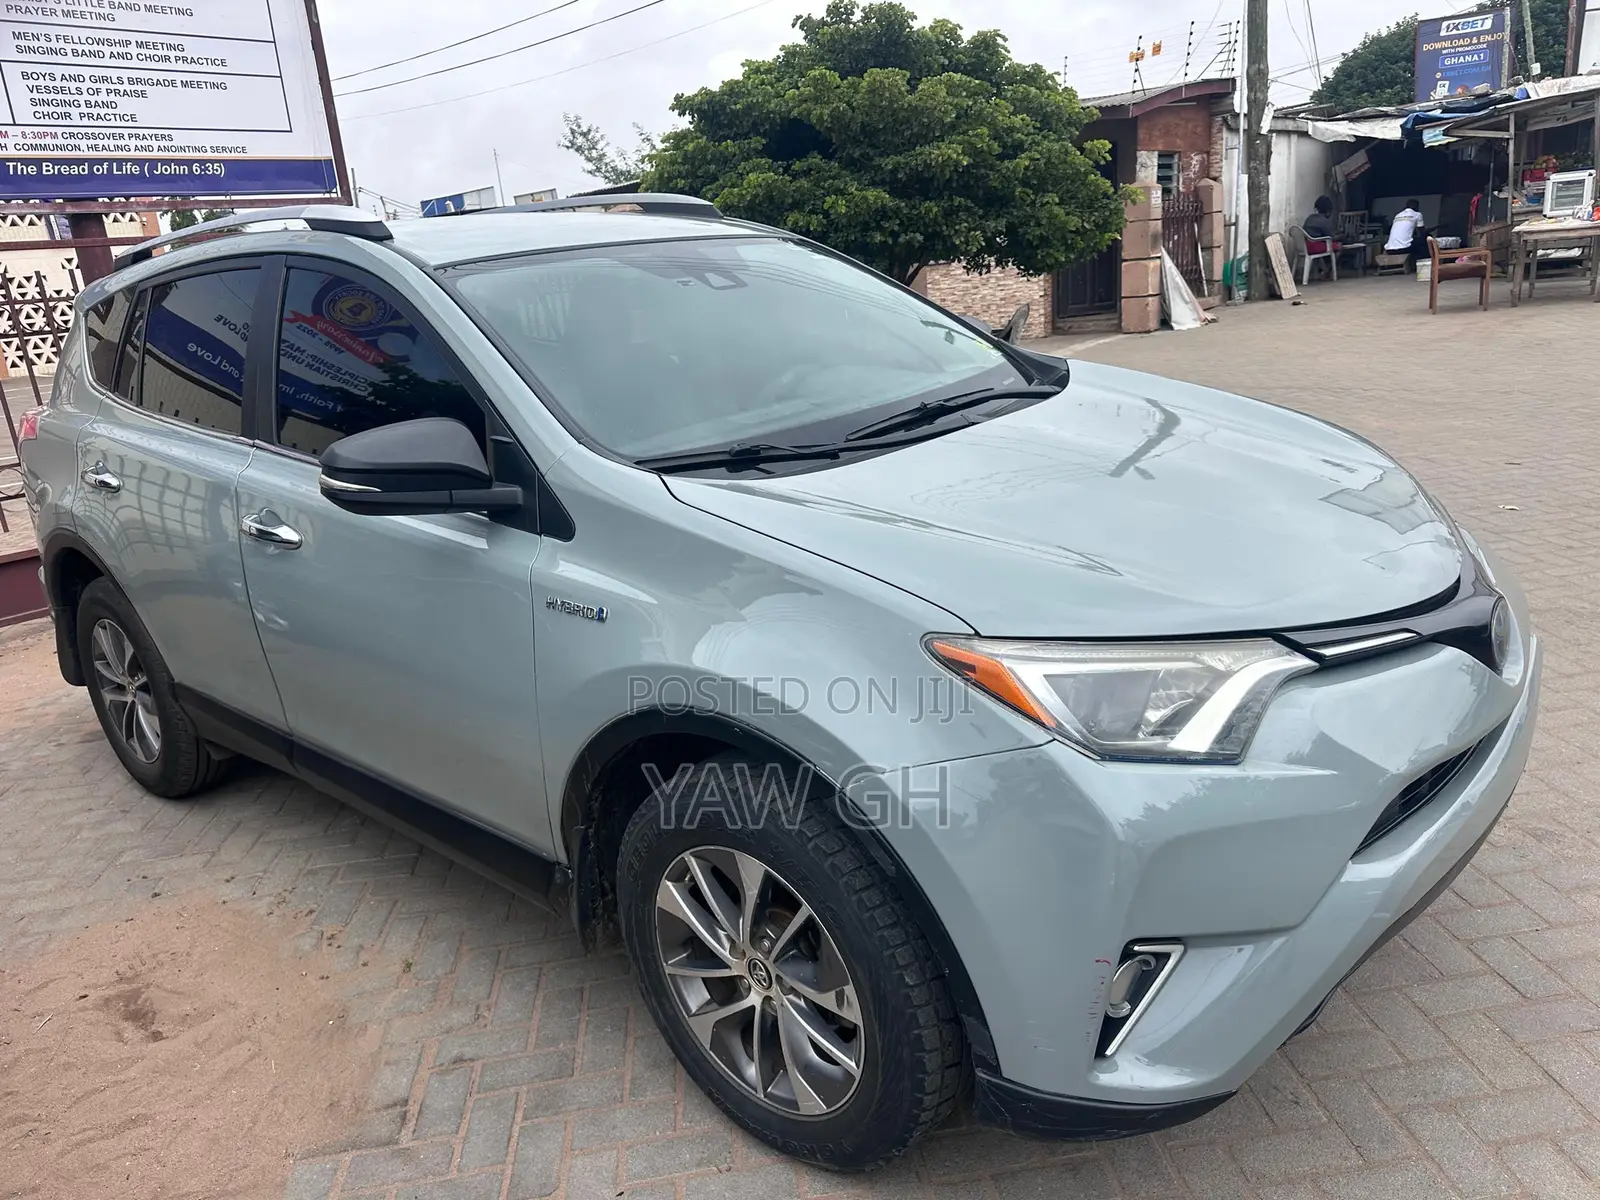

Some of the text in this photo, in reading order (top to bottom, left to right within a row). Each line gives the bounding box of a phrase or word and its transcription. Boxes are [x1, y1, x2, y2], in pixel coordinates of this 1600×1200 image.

[5, 4, 116, 22] PRAYER MEETING
[108, 0, 141, 12] BAND
[144, 4, 194, 17] MEETING
[1445, 19, 1487, 33] 1XBET
[55, 34, 132, 48] FELLOWSHIP
[135, 40, 185, 52] MEETING
[1423, 32, 1506, 51] DOWNLOAD & ENJOY
[1456, 43, 1487, 53] PROMOCODE
[15, 44, 228, 67] SINGING BAND AND CHOIR PRACTICE
[21, 71, 227, 90] BOYS AND GIRLS BRIGADE MEETING
[26, 84, 148, 98] VESSELS OF PRAISE
[29, 97, 118, 109] SINGING BAND
[33, 110, 138, 122] CHOIR PRACTICE
[21, 130, 59, 140] 8:30PM
[61, 131, 126, 141] CROSSOVER
[128, 133, 174, 142] PRAYERS
[14, 143, 85, 153] COMMUNION,
[87, 144, 131, 153] HEALING
[134, 144, 154, 153] AND
[157, 145, 208, 154] ANOINTING
[210, 146, 248, 154] SERVICE
[5, 162, 38, 175] The
[42, 162, 88, 175] Bread
[93, 162, 109, 175] of
[113, 162, 140, 175] Life
[153, 162, 188, 175] John
[192, 162, 225, 178] 6:35)
[546, 596, 597, 620] HYBRID
